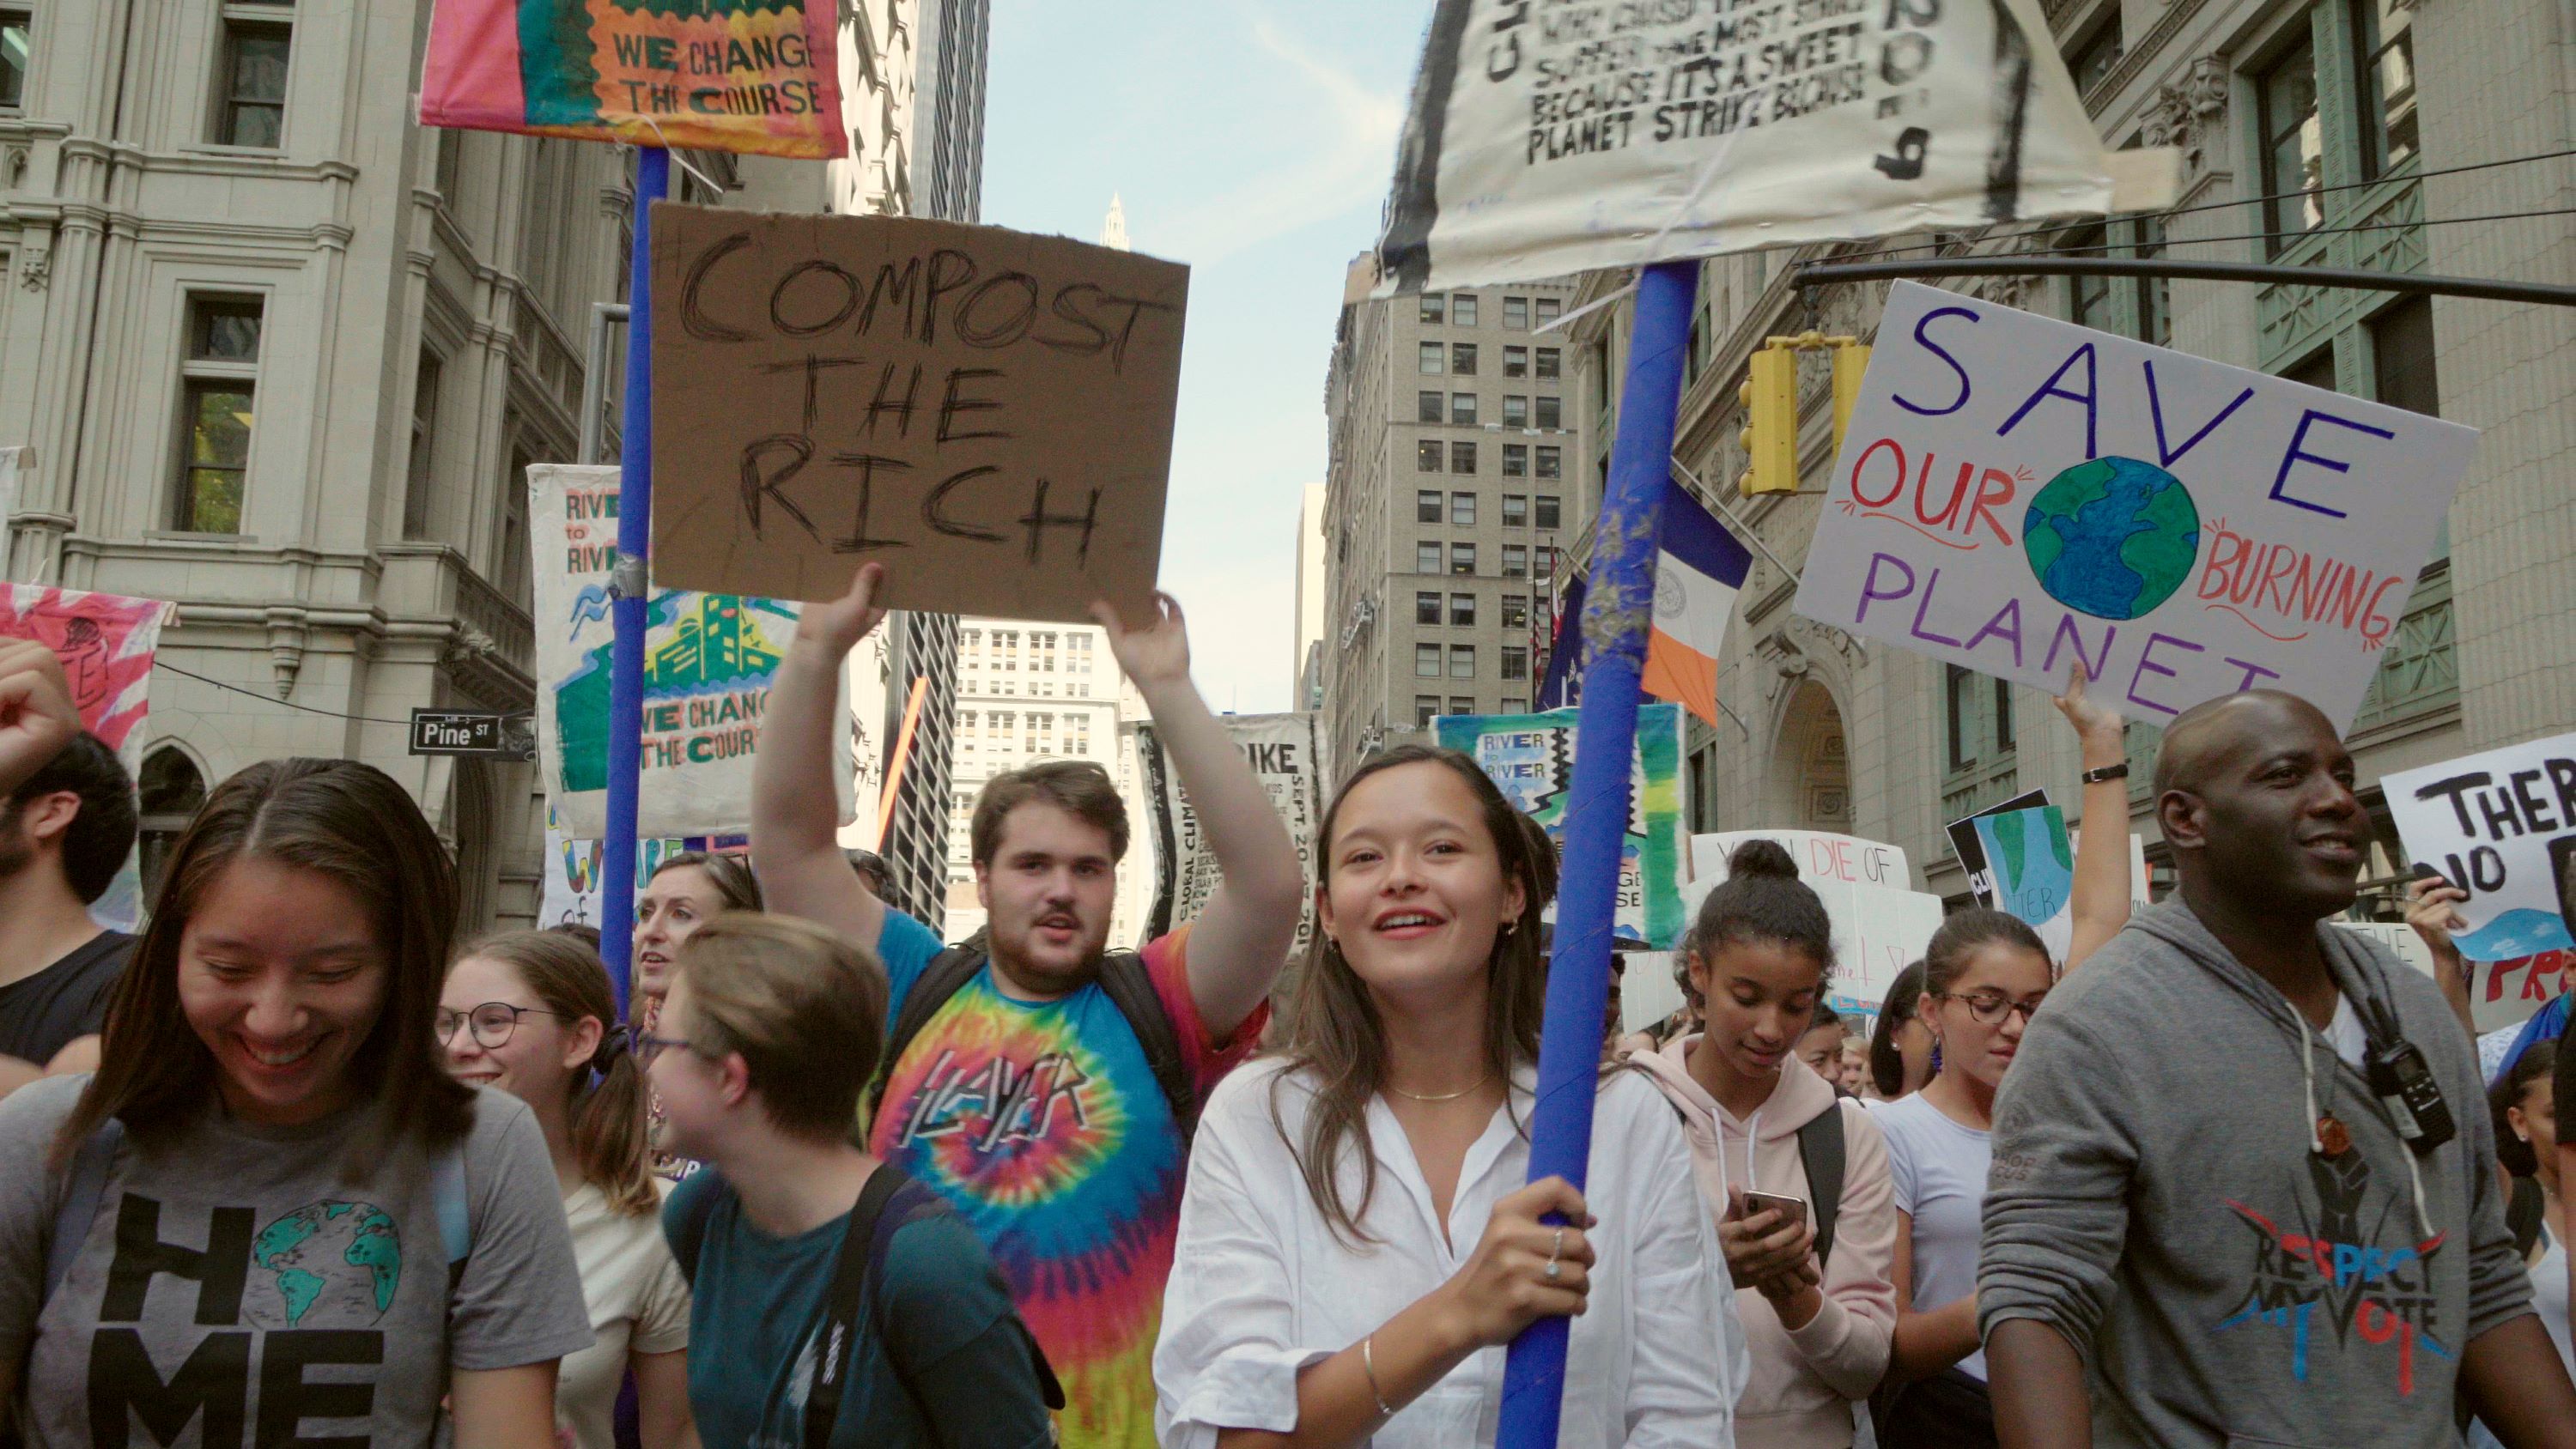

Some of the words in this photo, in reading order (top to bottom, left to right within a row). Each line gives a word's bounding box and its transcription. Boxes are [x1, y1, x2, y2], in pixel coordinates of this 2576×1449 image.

[613, 33, 677, 72] WE
[689, 80, 824, 115] COURSE
[1527, 111, 1634, 166] PLANET
[1654, 89, 1761, 142] STRIKE
[678, 230, 1185, 376] COMPOST
[749, 353, 1024, 452] THE
[1891, 306, 2396, 519] SAVE
[566, 494, 620, 520] RIVE
[740, 432, 1103, 571] RICH
[566, 528, 586, 541] to
[1850, 437, 2016, 547] OUR
[2196, 530, 2403, 640] BURNING
[1855, 552, 2281, 716] PLANET
[424, 723, 471, 746] Pine
[476, 724, 489, 737] ST
[689, 690, 769, 729] CHAN
[688, 728, 756, 764] COUR
[1484, 733, 1543, 751] RIVER
[1486, 762, 1545, 779] RIVER
[2414, 758, 2576, 841] THER
[1295, 834, 1309, 863] 20
[1810, 838, 1856, 882] DIE
[1863, 846, 1890, 885] OF
[2414, 846, 2506, 902] NO
[1179, 857, 1195, 922] GLOBAL
[2239, 1219, 2445, 1293] RESPECT
